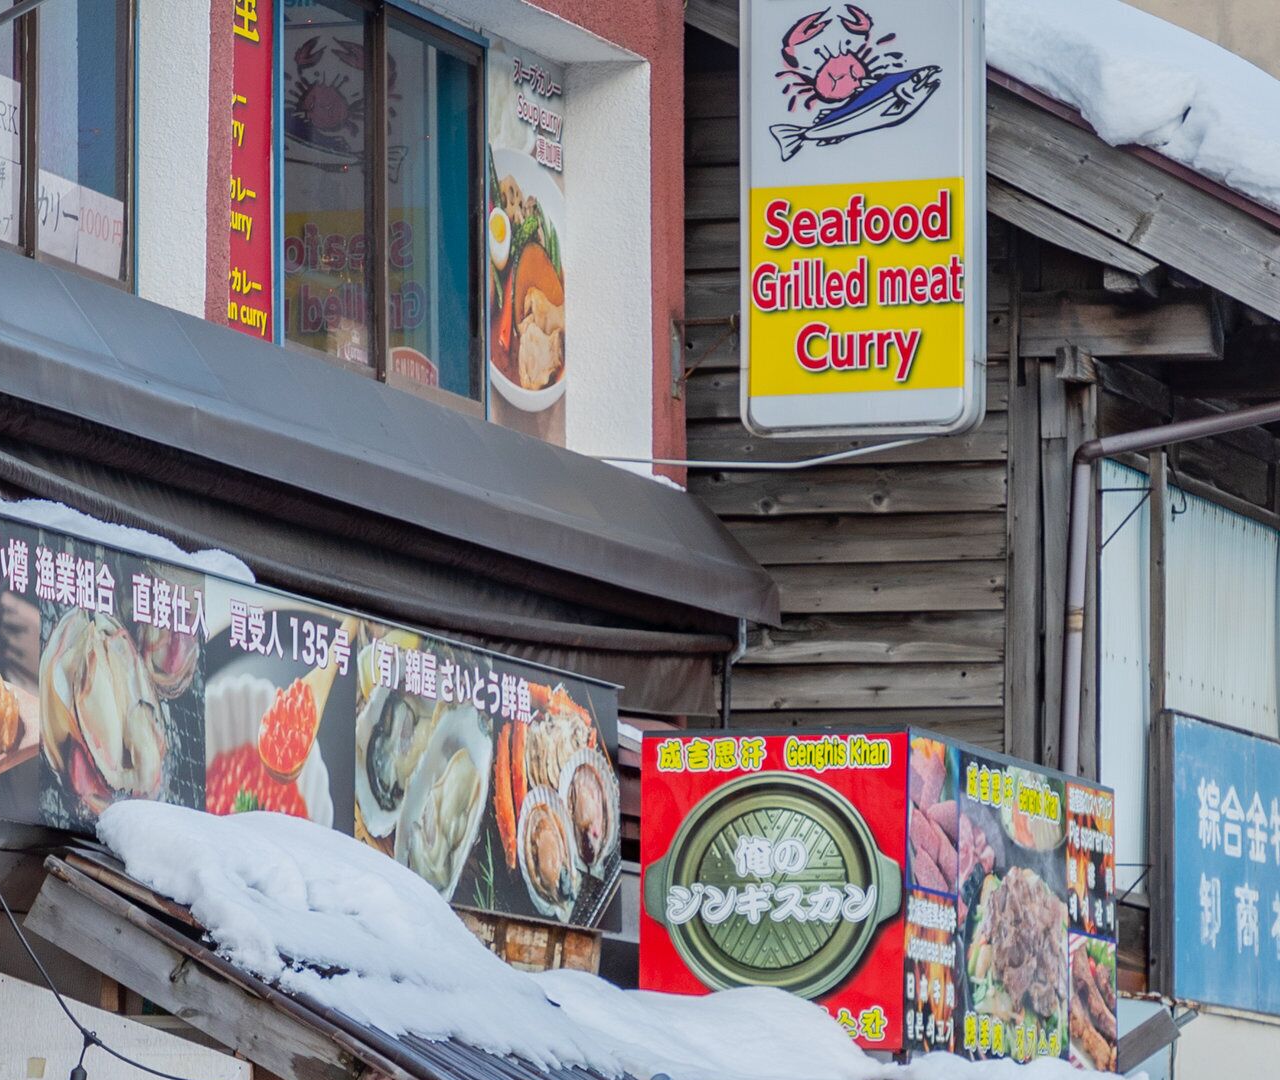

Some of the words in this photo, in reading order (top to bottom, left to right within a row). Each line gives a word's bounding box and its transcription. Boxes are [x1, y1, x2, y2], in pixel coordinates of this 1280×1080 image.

[765, 189, 950, 248] Seafood
[752, 256, 868, 312] Grilled
[879, 256, 964, 306] meat
[795, 322, 920, 382] Curry
[657, 736, 767, 772] 成吉思汗
[785, 736, 848, 773] Genghis
[849, 735, 891, 770] Khan
[735, 834, 809, 878] 俺の
[666, 882, 877, 925] ジンギスカン
